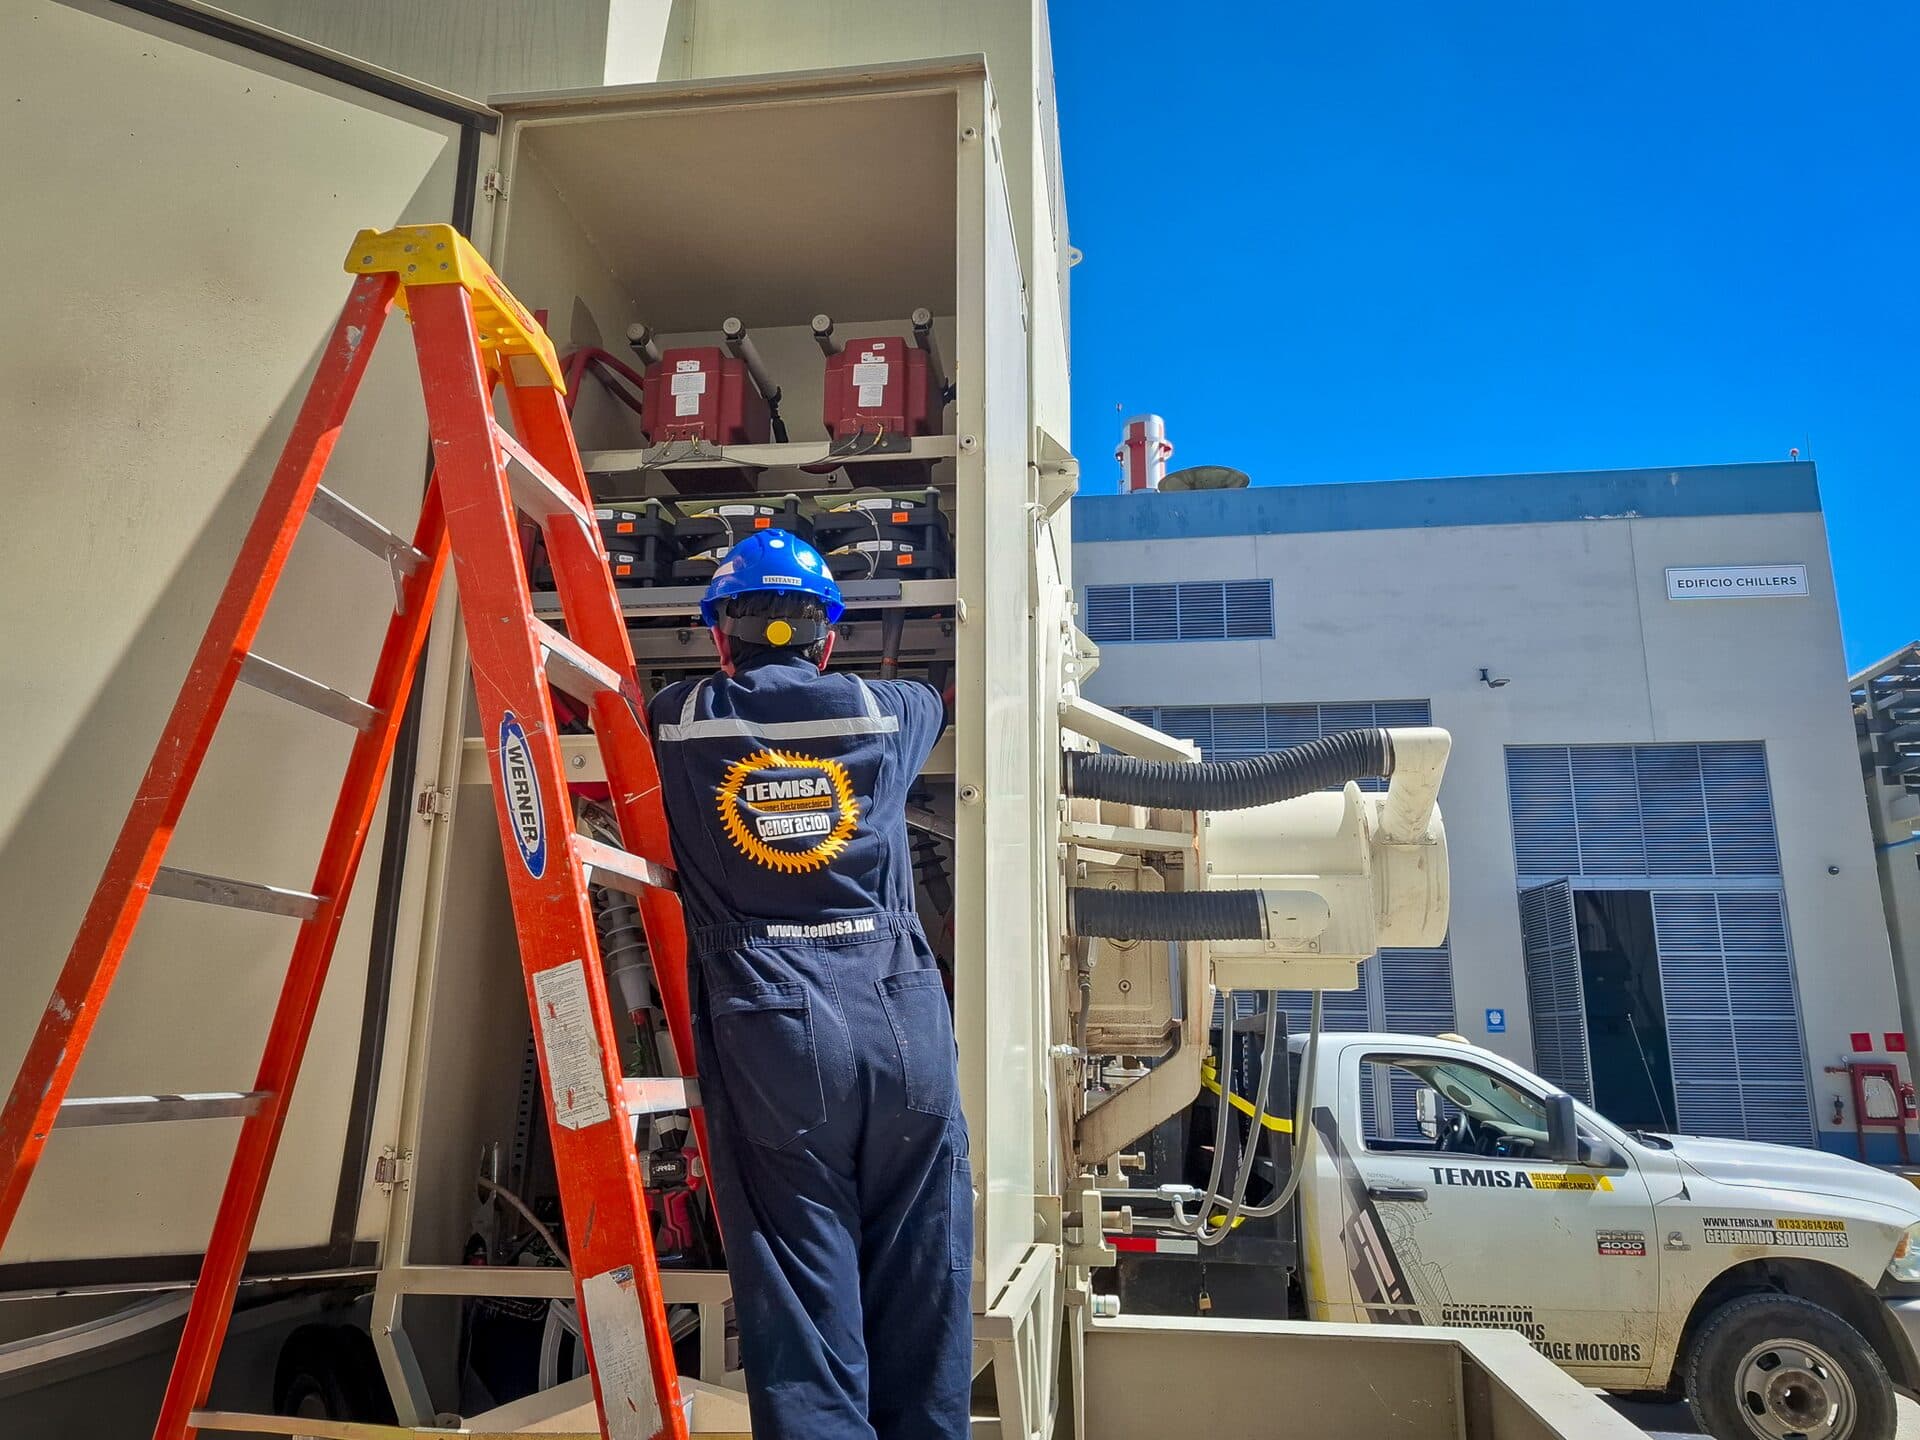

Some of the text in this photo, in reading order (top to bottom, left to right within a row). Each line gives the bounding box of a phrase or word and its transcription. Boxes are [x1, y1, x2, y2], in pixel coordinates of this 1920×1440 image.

[764, 576, 801, 585] VISITANTE
[1677, 576, 1798, 589] EDIFICIO CHILLERS
[507, 744, 538, 844] WERNER
[743, 777, 832, 802] TEMISA
[766, 917, 875, 938] www.temisa.mx
[1428, 1166, 1534, 1189] TEMISA
[1702, 1217, 1775, 1229] WWW.TEMISA.MX
[1600, 1242, 1643, 1250] 4000
[1705, 1229, 1849, 1247] GENERANDO SOLUCIONES
[1442, 1303, 1533, 1323] GENERATION
[1575, 1343, 1641, 1361] MOTORS
